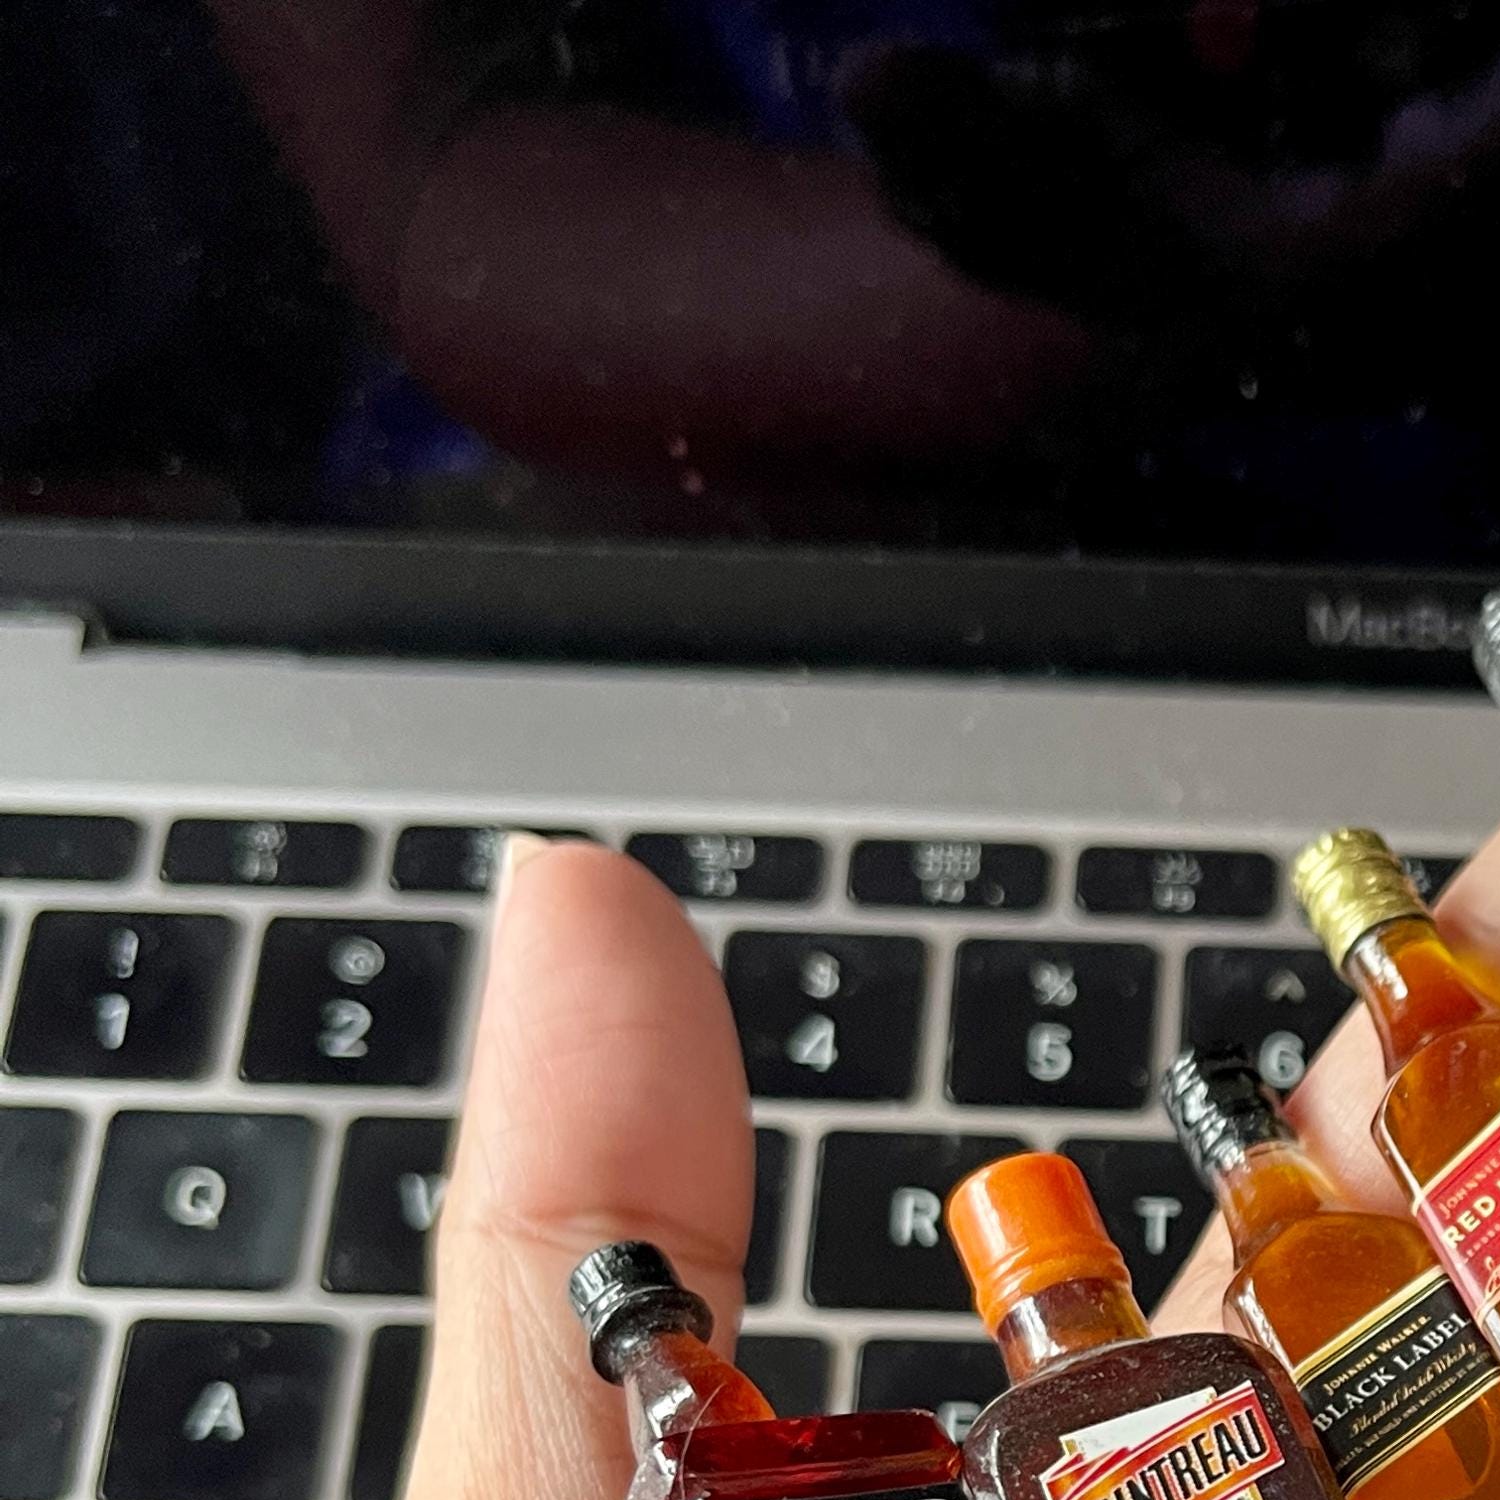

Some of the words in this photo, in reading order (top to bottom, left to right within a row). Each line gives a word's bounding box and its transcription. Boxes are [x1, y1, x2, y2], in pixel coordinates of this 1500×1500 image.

[316, 999, 373, 1058] 2
[788, 1014, 840, 1073] 4
[1026, 1021, 1074, 1083] 5
[1258, 1030, 1306, 1090] 6
[164, 1166, 227, 1230] Q
[888, 1186, 941, 1248] R
[1437, 1156, 1500, 1221] JOHNNIE
[1133, 1197, 1182, 1254] T
[1441, 1194, 1497, 1250] RED
[1311, 1369, 1397, 1434] BLACK
[1392, 1311, 1473, 1371] LABEL
[1322, 1350, 1378, 1397] JOHNNIE
[184, 1381, 244, 1441] A
